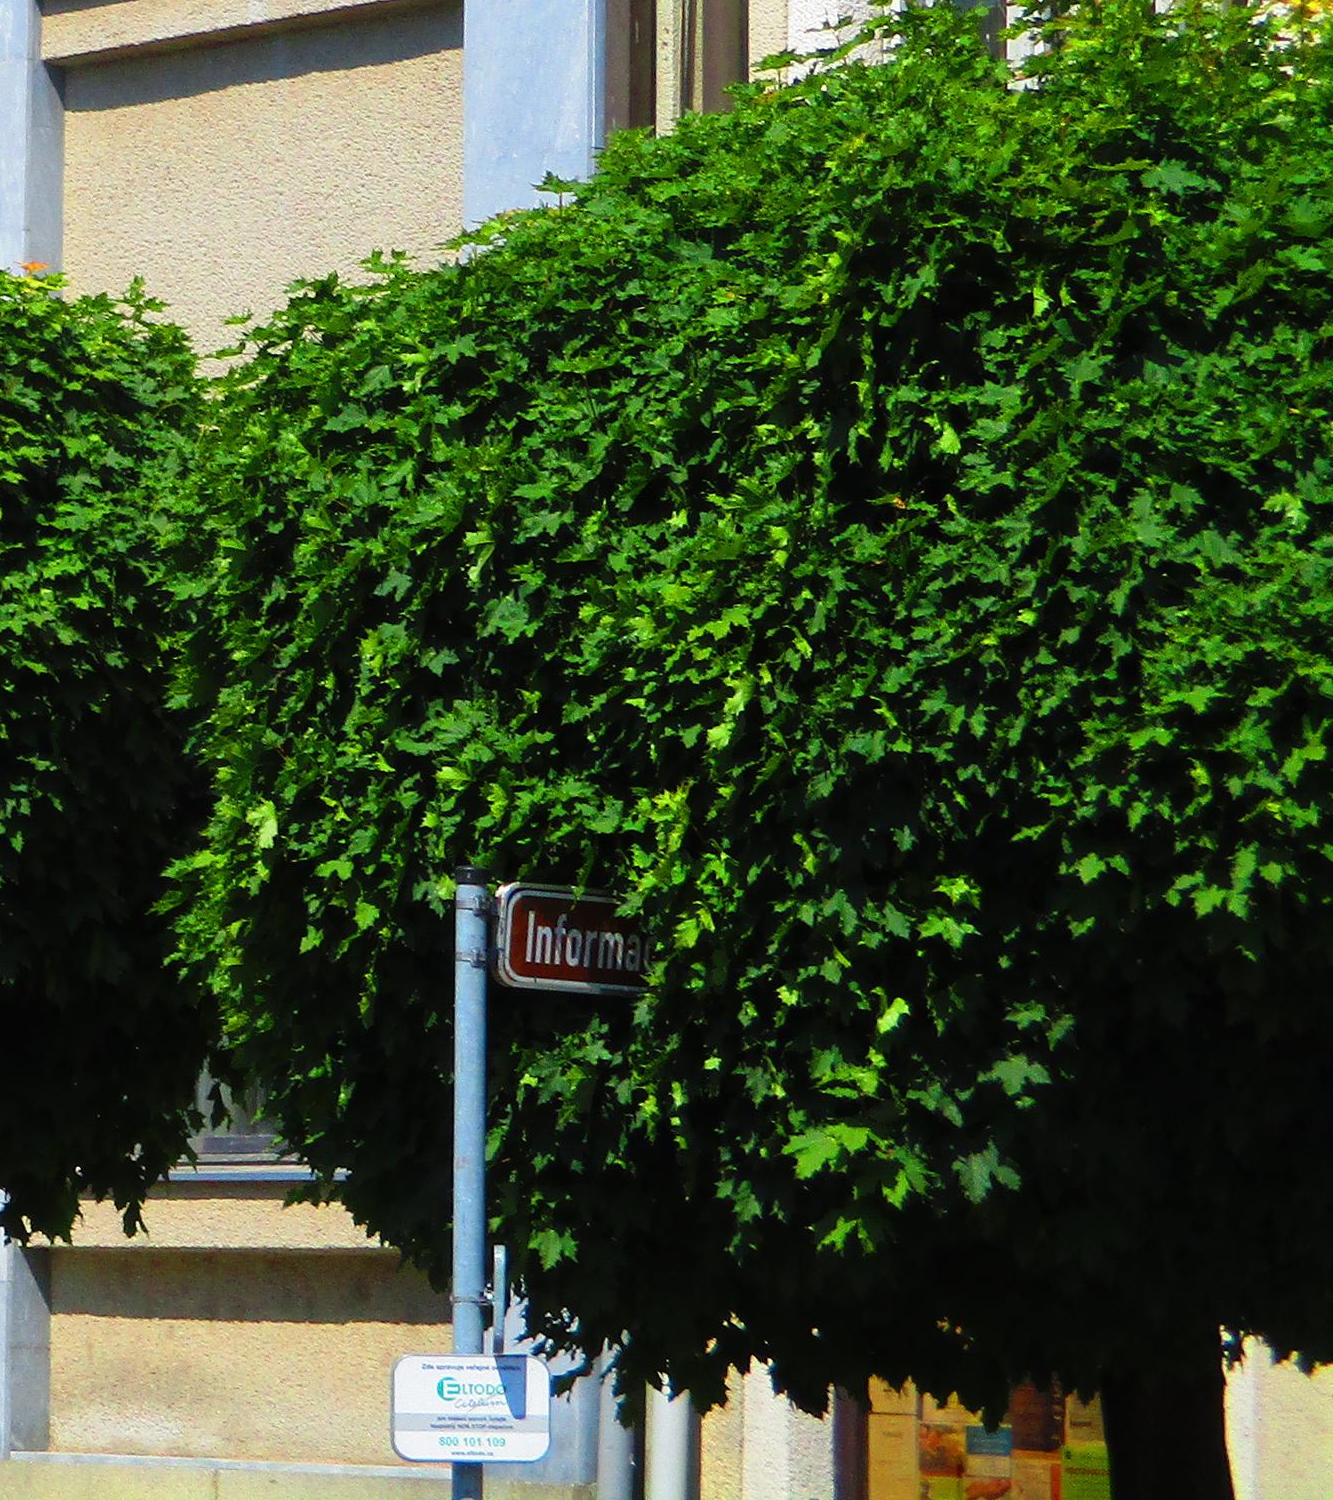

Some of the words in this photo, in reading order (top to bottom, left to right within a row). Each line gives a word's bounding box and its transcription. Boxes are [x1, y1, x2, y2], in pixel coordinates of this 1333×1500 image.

[437, 1377, 506, 1401] ELTODO
[438, 1436, 459, 1446] 800
[463, 1437, 482, 1447] 101
[486, 1437, 506, 1448] 109
